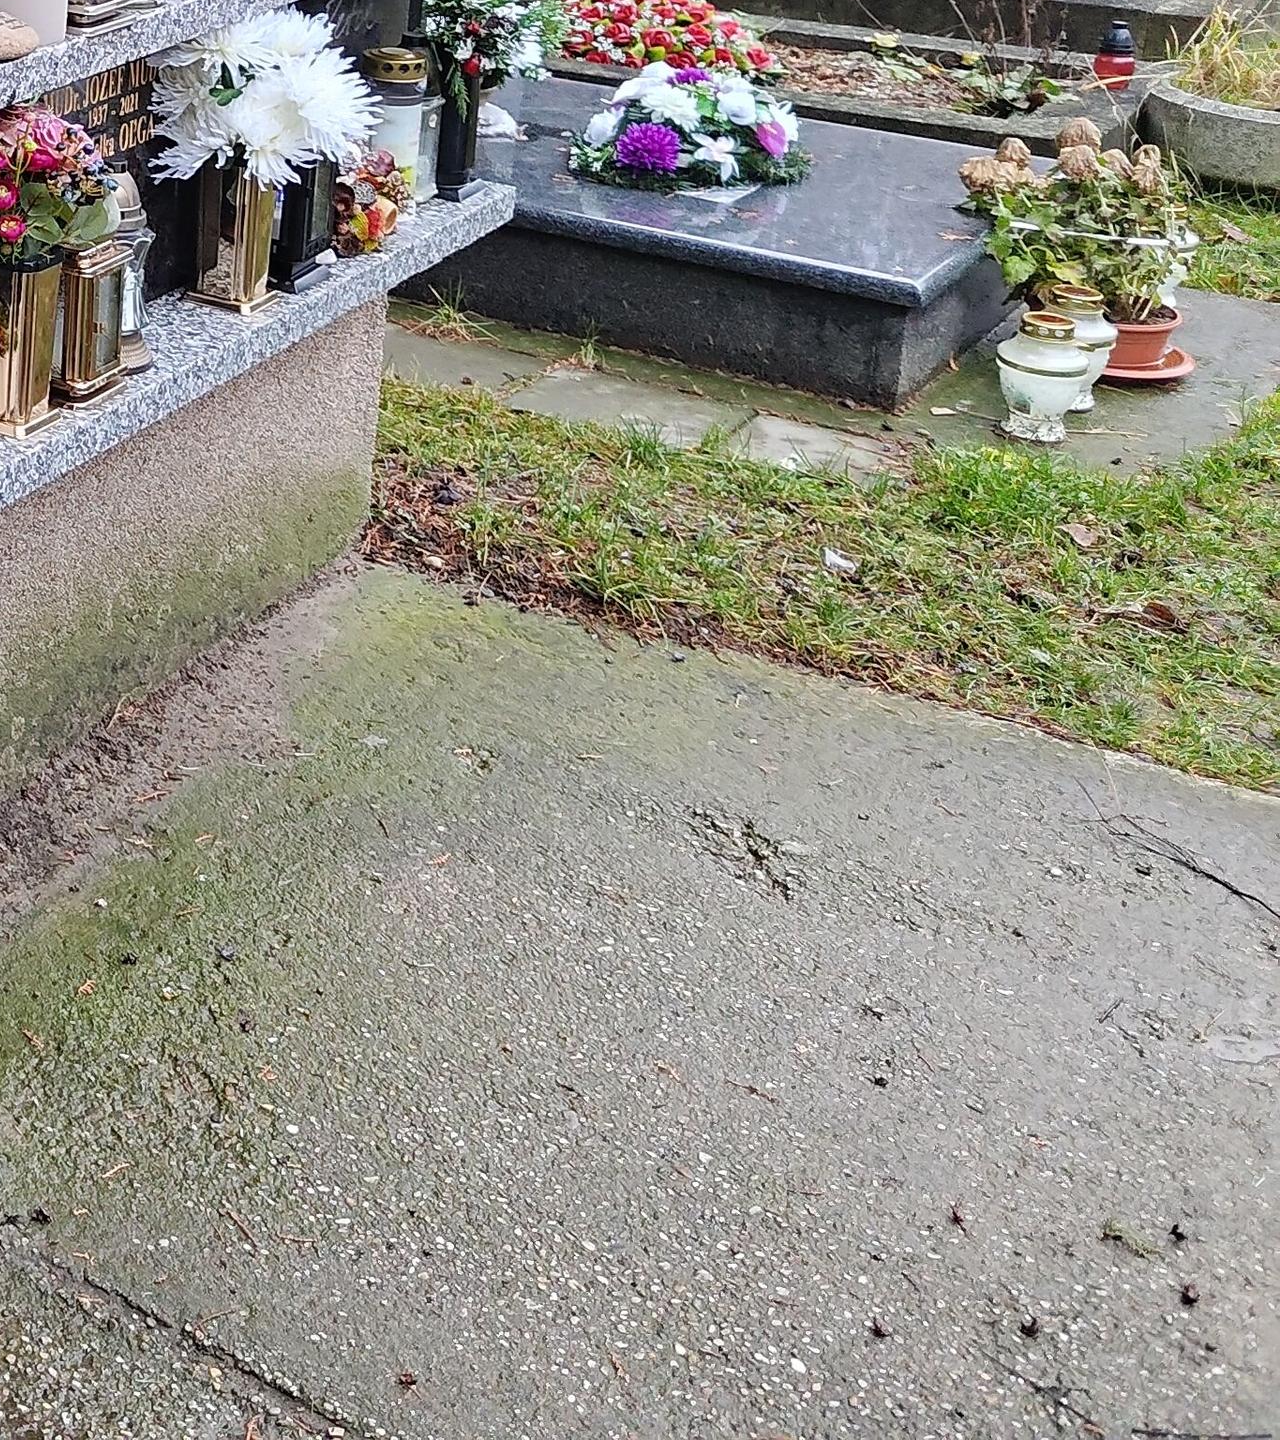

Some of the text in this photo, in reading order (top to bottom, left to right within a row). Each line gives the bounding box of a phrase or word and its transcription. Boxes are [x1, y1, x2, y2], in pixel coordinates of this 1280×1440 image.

[82, 65, 126, 108] JOZEF
[87, 103, 109, 129] 1937
[119, 92, 139, 117] 2021
